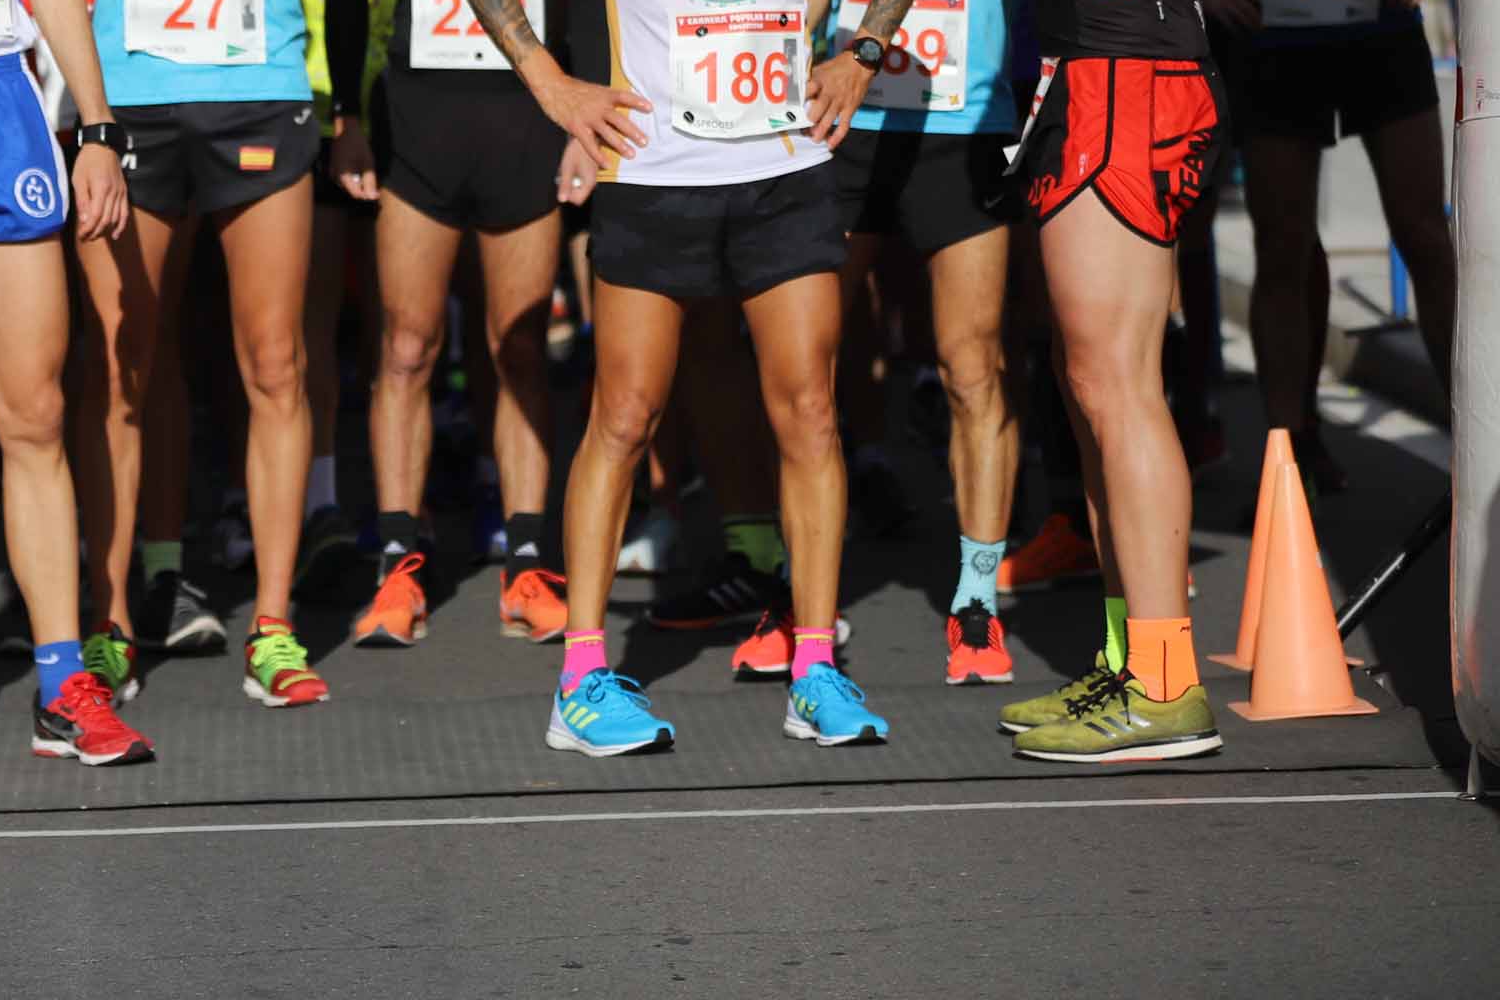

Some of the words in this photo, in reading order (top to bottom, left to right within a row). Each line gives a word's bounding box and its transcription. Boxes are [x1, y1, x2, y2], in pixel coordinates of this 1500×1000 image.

[884, 27, 948, 77] 89
[694, 51, 789, 104] 186
[693, 119, 734, 129] SPRODES
